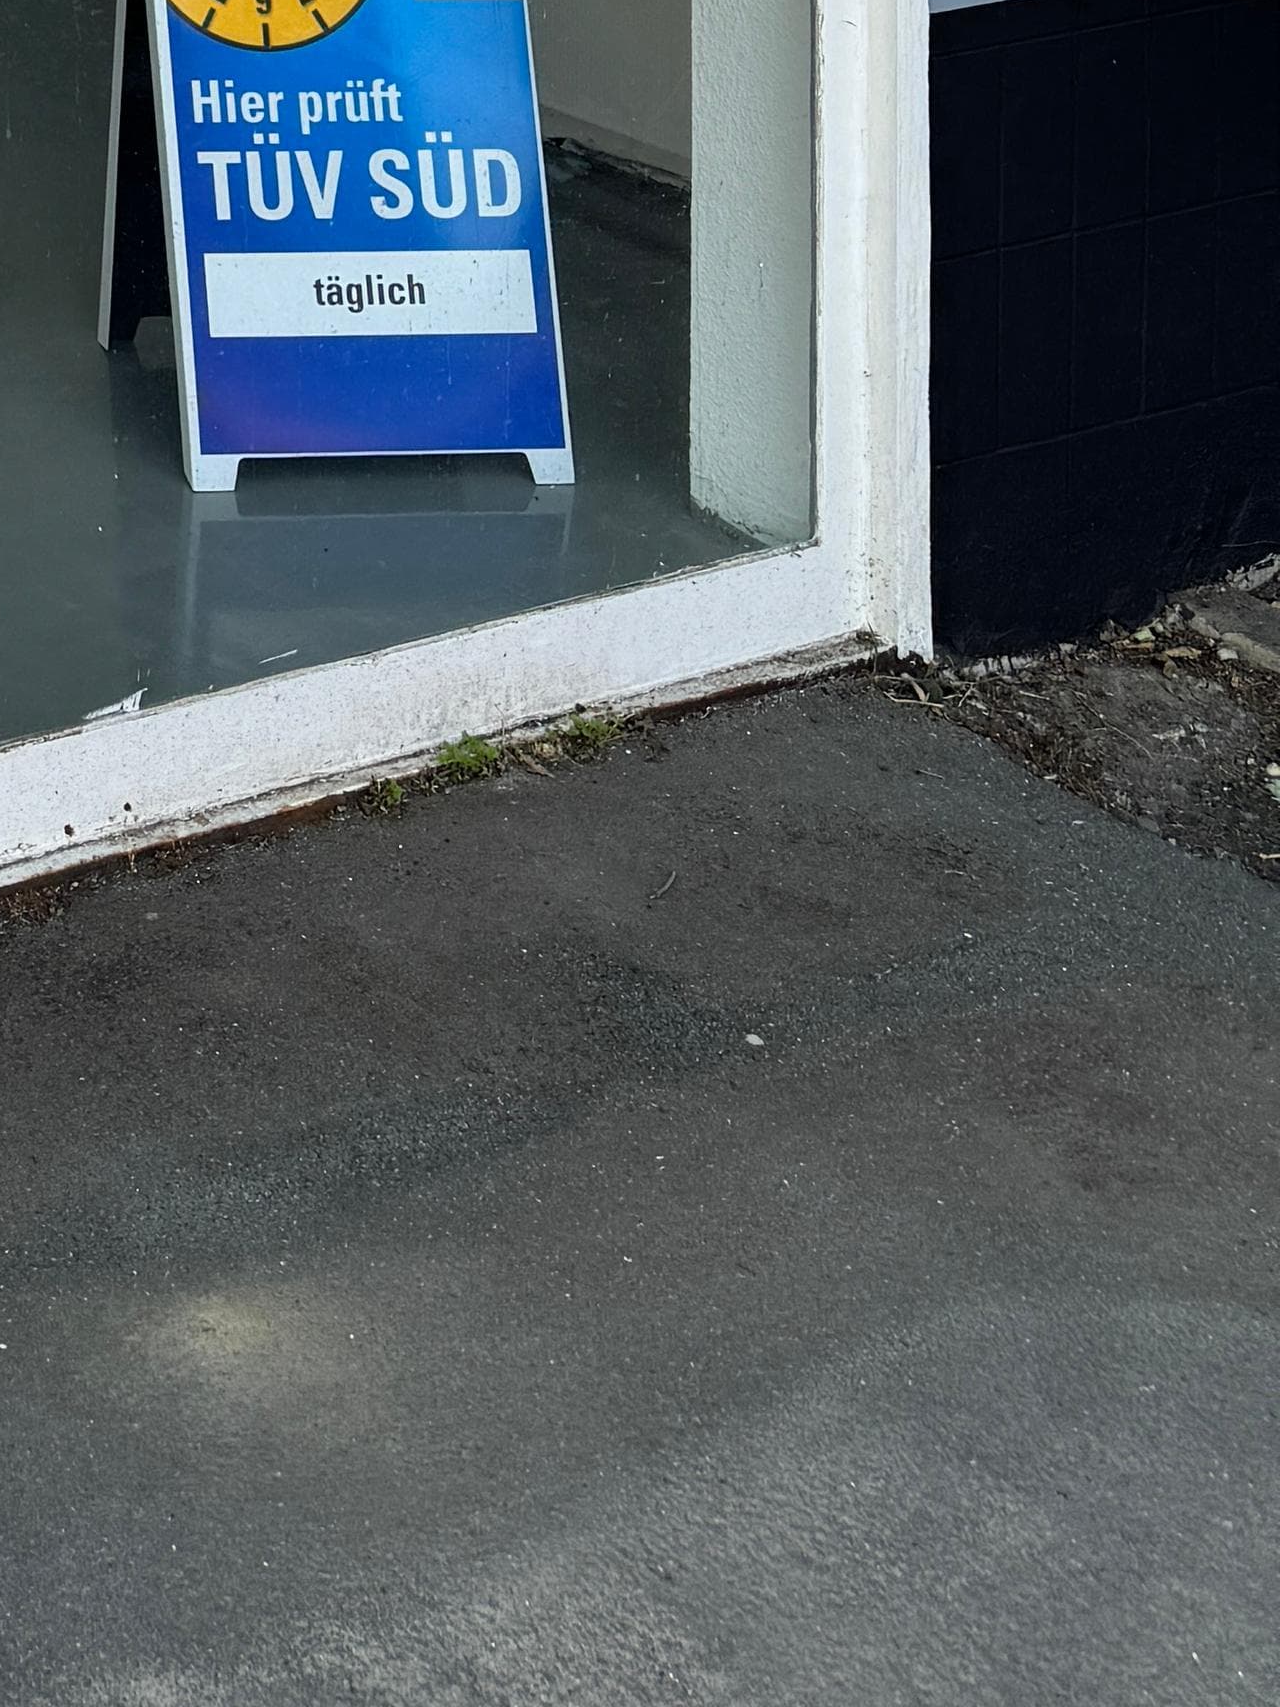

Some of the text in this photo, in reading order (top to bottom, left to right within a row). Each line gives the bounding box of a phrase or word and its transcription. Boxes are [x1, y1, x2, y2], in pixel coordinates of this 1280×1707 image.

[191, 78, 403, 135] Hier prüft
[197, 130, 522, 221] TÜV SÜD
[313, 273, 426, 313] täglich
